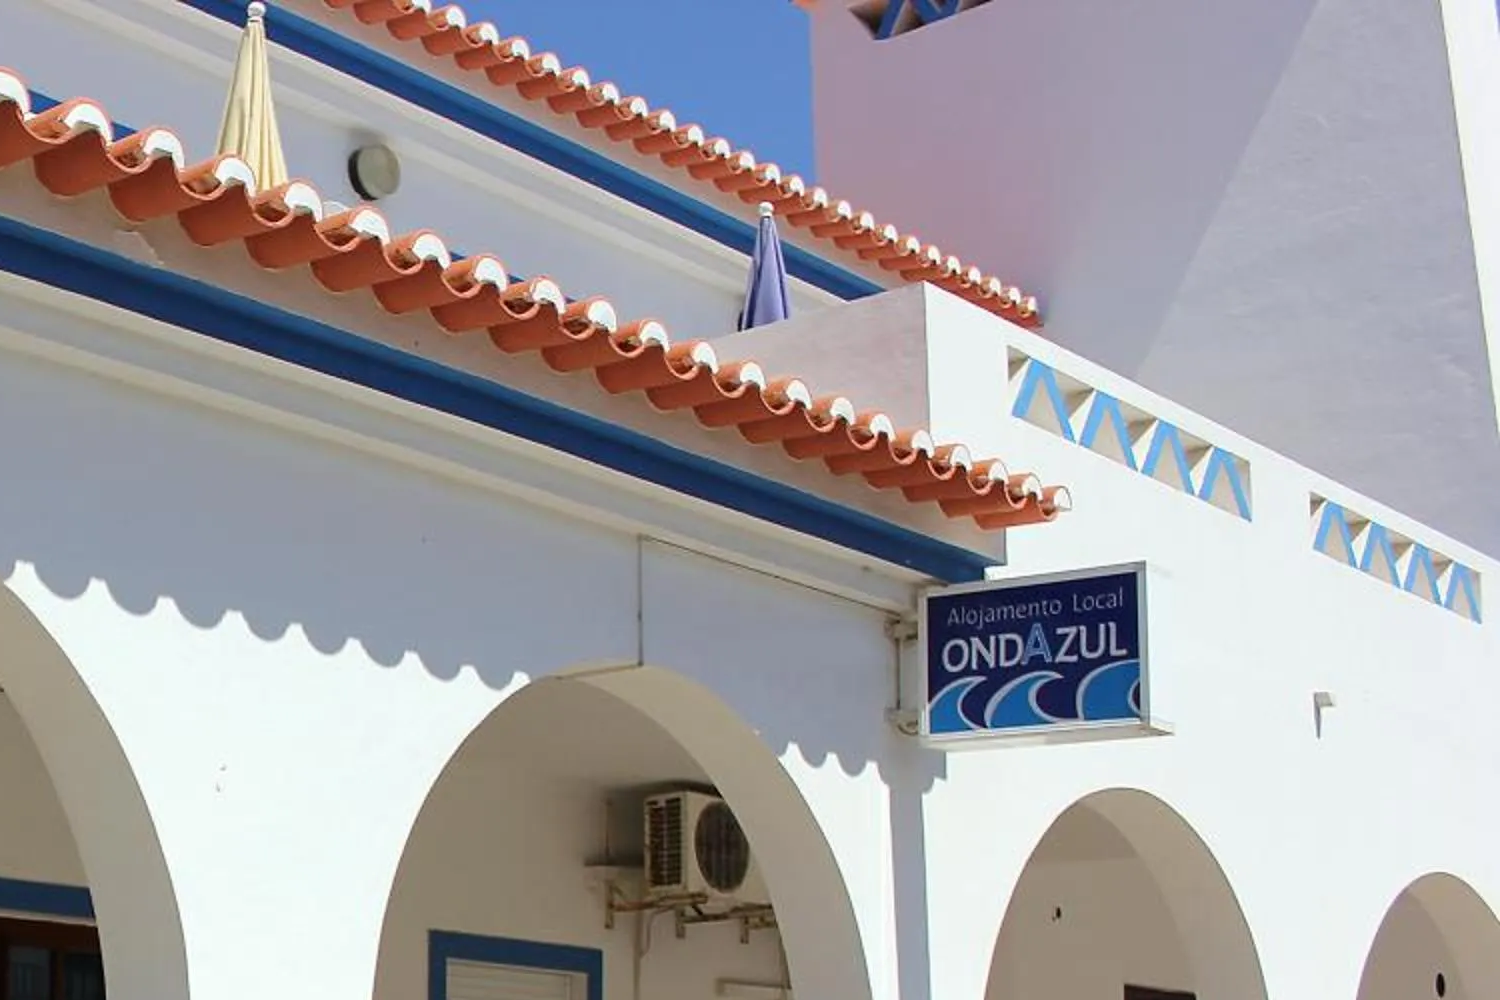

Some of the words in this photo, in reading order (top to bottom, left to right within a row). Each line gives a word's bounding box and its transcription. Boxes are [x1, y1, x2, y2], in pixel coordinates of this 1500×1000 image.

[947, 599, 1063, 630] Alojamento
[1073, 586, 1124, 614] Local
[941, 620, 1129, 673] ONDAZUL
